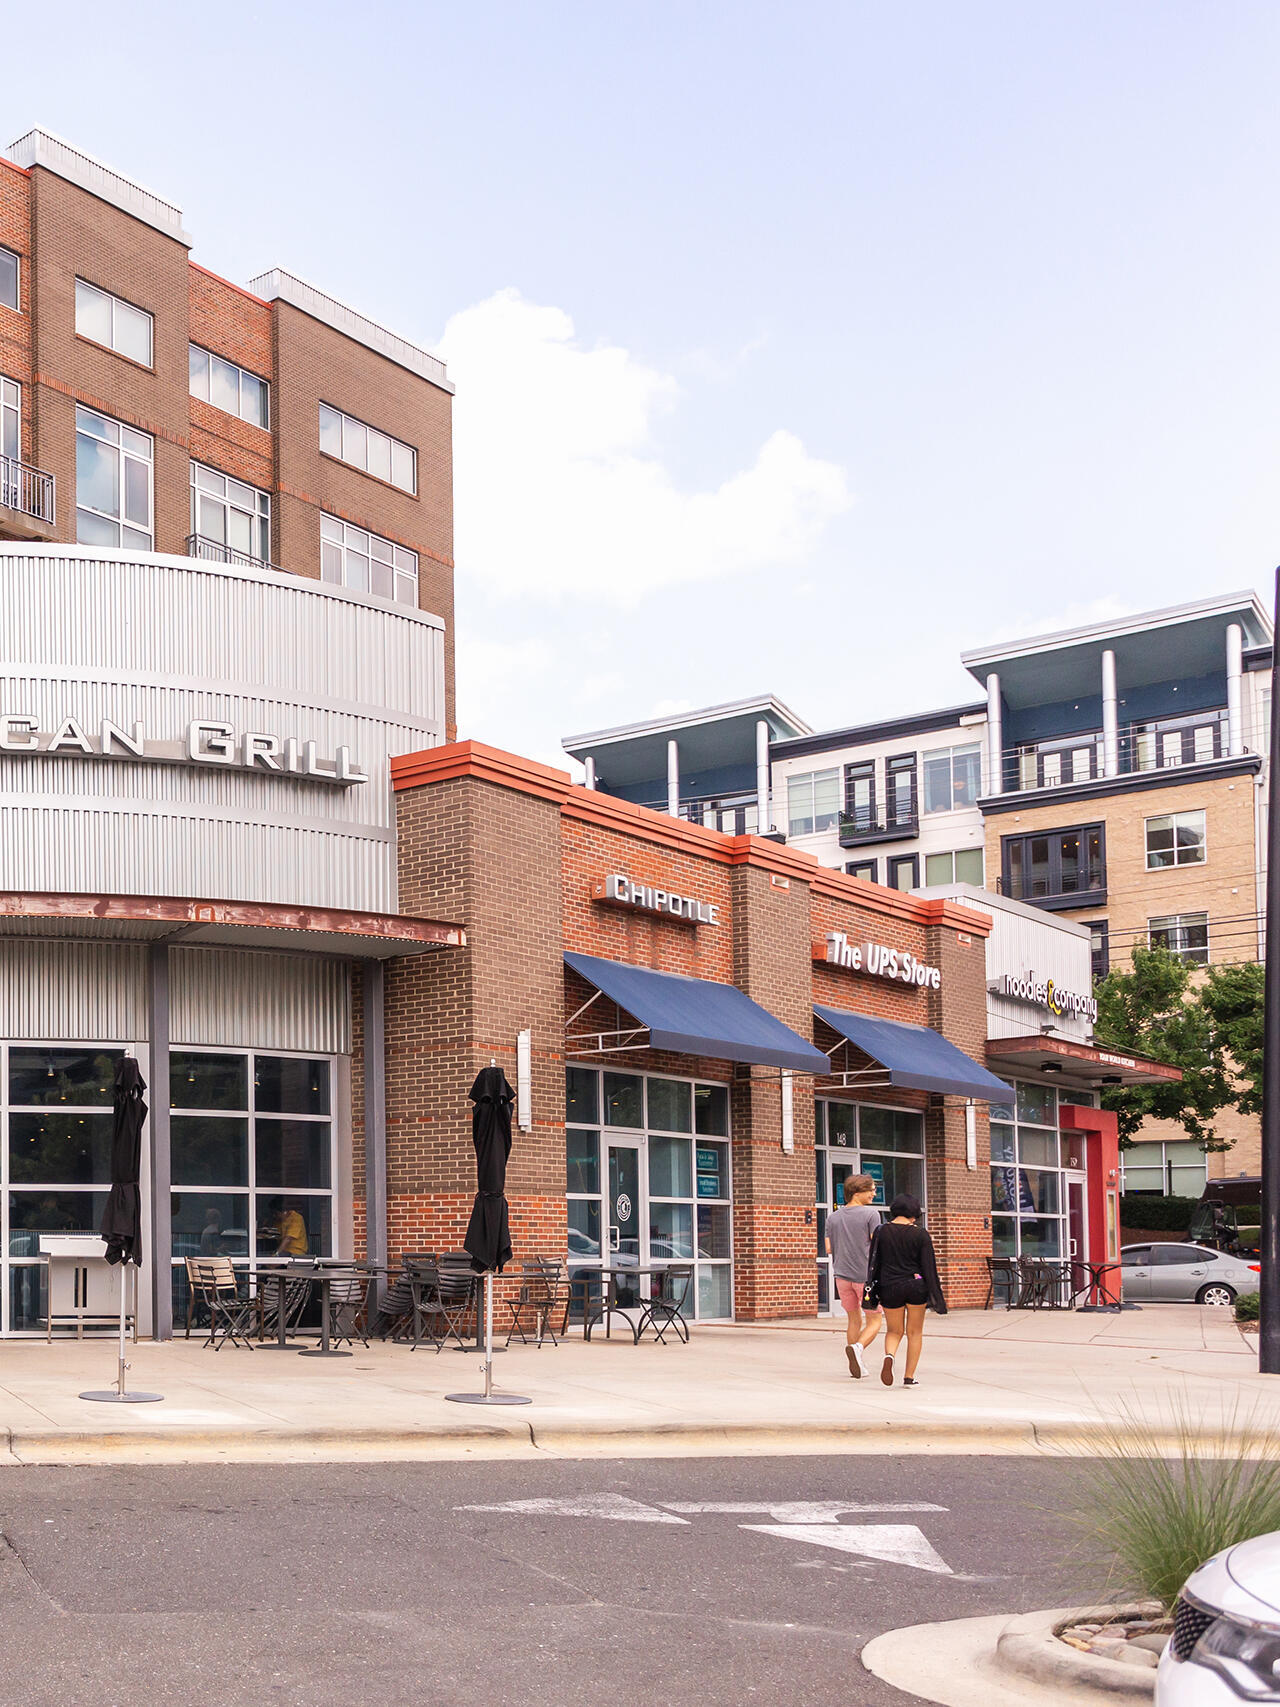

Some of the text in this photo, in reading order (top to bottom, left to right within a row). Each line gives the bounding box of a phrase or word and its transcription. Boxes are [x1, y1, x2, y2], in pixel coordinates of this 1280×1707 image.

[187, 718, 369, 785] GRILL
[609, 874, 720, 926] CHIPOTLE
[830, 932, 941, 989] The UPS Store
